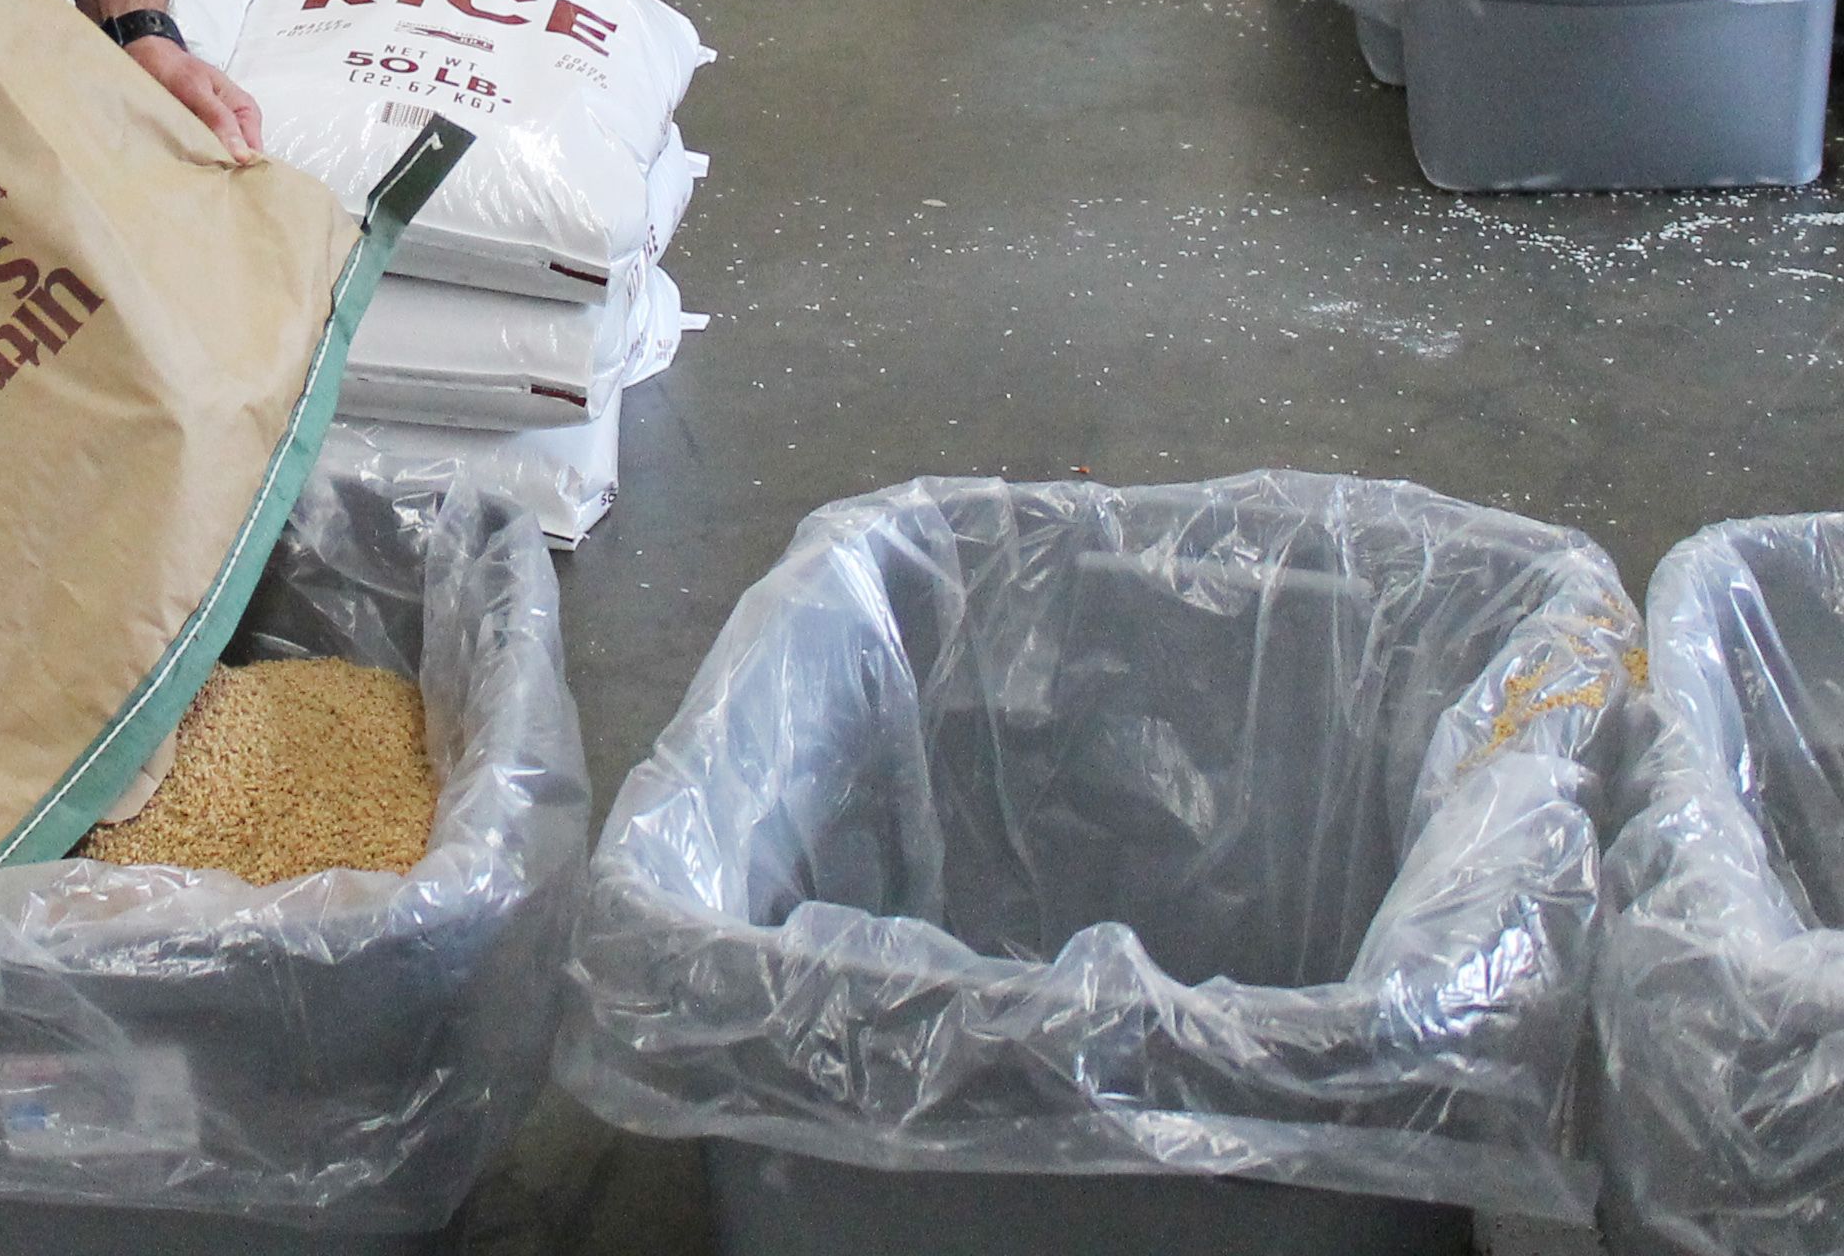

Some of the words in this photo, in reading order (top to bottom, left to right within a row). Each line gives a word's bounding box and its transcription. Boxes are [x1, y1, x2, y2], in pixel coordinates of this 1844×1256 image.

[384, 44, 428, 60] NET
[342, 50, 420, 74] 50
[433, 66, 513, 104] LB.
